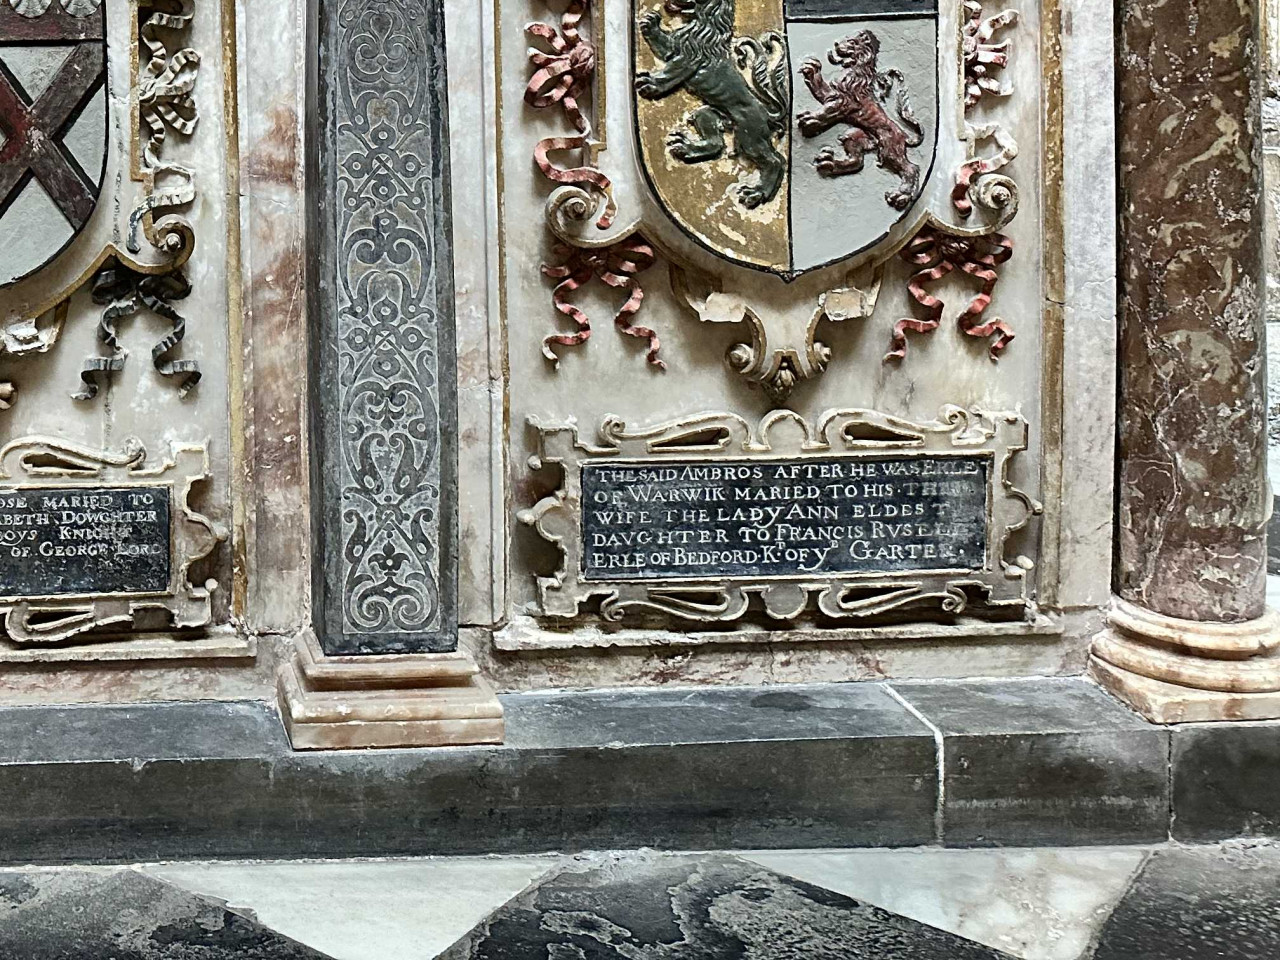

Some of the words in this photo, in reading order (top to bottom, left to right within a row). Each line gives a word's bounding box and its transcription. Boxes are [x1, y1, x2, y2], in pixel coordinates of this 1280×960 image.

[595, 468, 636, 484] THE
[638, 467, 678, 483] SAID
[680, 465, 764, 482] AMBROS
[773, 462, 845, 480] AFTER
[850, 462, 877, 478] HE
[42, 494, 115, 510] MARIED
[128, 492, 155, 506] TO
[594, 488, 625, 506] OF
[627, 483, 726, 503] WARWIK
[734, 484, 822, 502] MARIED
[825, 483, 858, 500] TO
[593, 509, 653, 526] WIFE
[661, 508, 710, 524] THE
[717, 505, 786, 529] LADY
[784, 501, 840, 521] ANN
[592, 526, 730, 548] DAVGHTER
[738, 526, 770, 543] TO
[775, 523, 864, 544] FRANCIS
[10, 546, 31, 559] OF
[39, 542, 109, 559] GEORGE
[592, 551, 648, 569] ERLE
[650, 552, 672, 566] OF
[785, 547, 811, 563] OF
